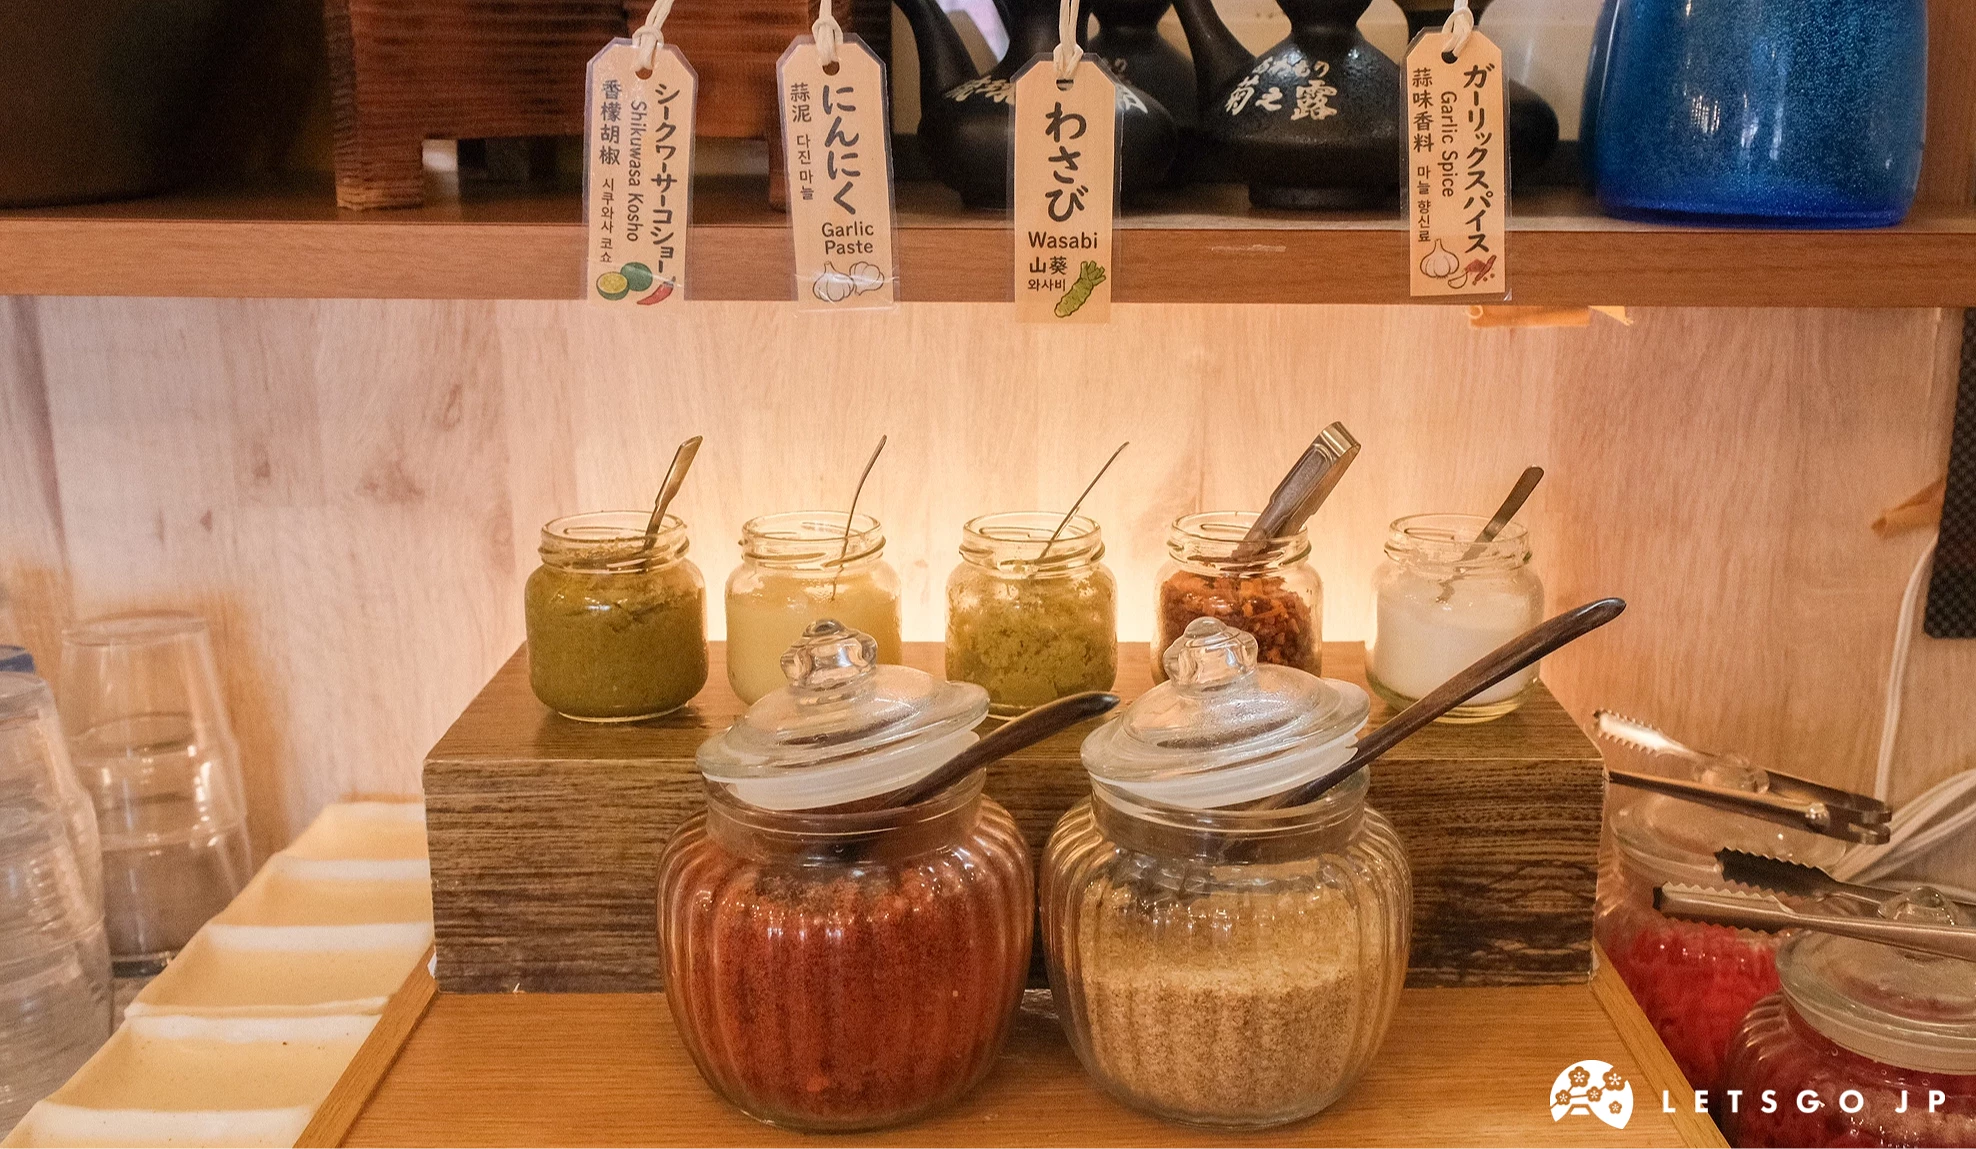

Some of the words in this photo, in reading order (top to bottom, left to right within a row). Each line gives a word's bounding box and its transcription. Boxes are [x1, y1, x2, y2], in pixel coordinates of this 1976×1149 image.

[790, 83, 812, 123] 蒜泥
[1412, 67, 1434, 153] 蒜味香料
[1440, 91, 1458, 144] Garlic
[628, 100, 648, 187] Shikuwasa
[796, 134, 811, 165] 다진
[822, 84, 861, 215] にんにく
[1044, 101, 1089, 222] わさび
[1463, 63, 1495, 254] ガーリックスパイス
[650, 83, 681, 273] シークワーサーコショー
[799, 169, 814, 200] 마늘
[1416, 165, 1431, 196] 마늘
[1437, 150, 1459, 197] Spice
[600, 178, 615, 234] 시쿠와사
[626, 192, 644, 242] Kosho
[1417, 199, 1432, 243] 향신료
[600, 237, 613, 263] 코쇼
[821, 221, 874, 238] Garlic
[824, 239, 874, 255] Paste
[1028, 231, 1098, 249] Wasabi
[1028, 278, 1066, 292] 와사비
[1029, 256, 1068, 275] 山葵
